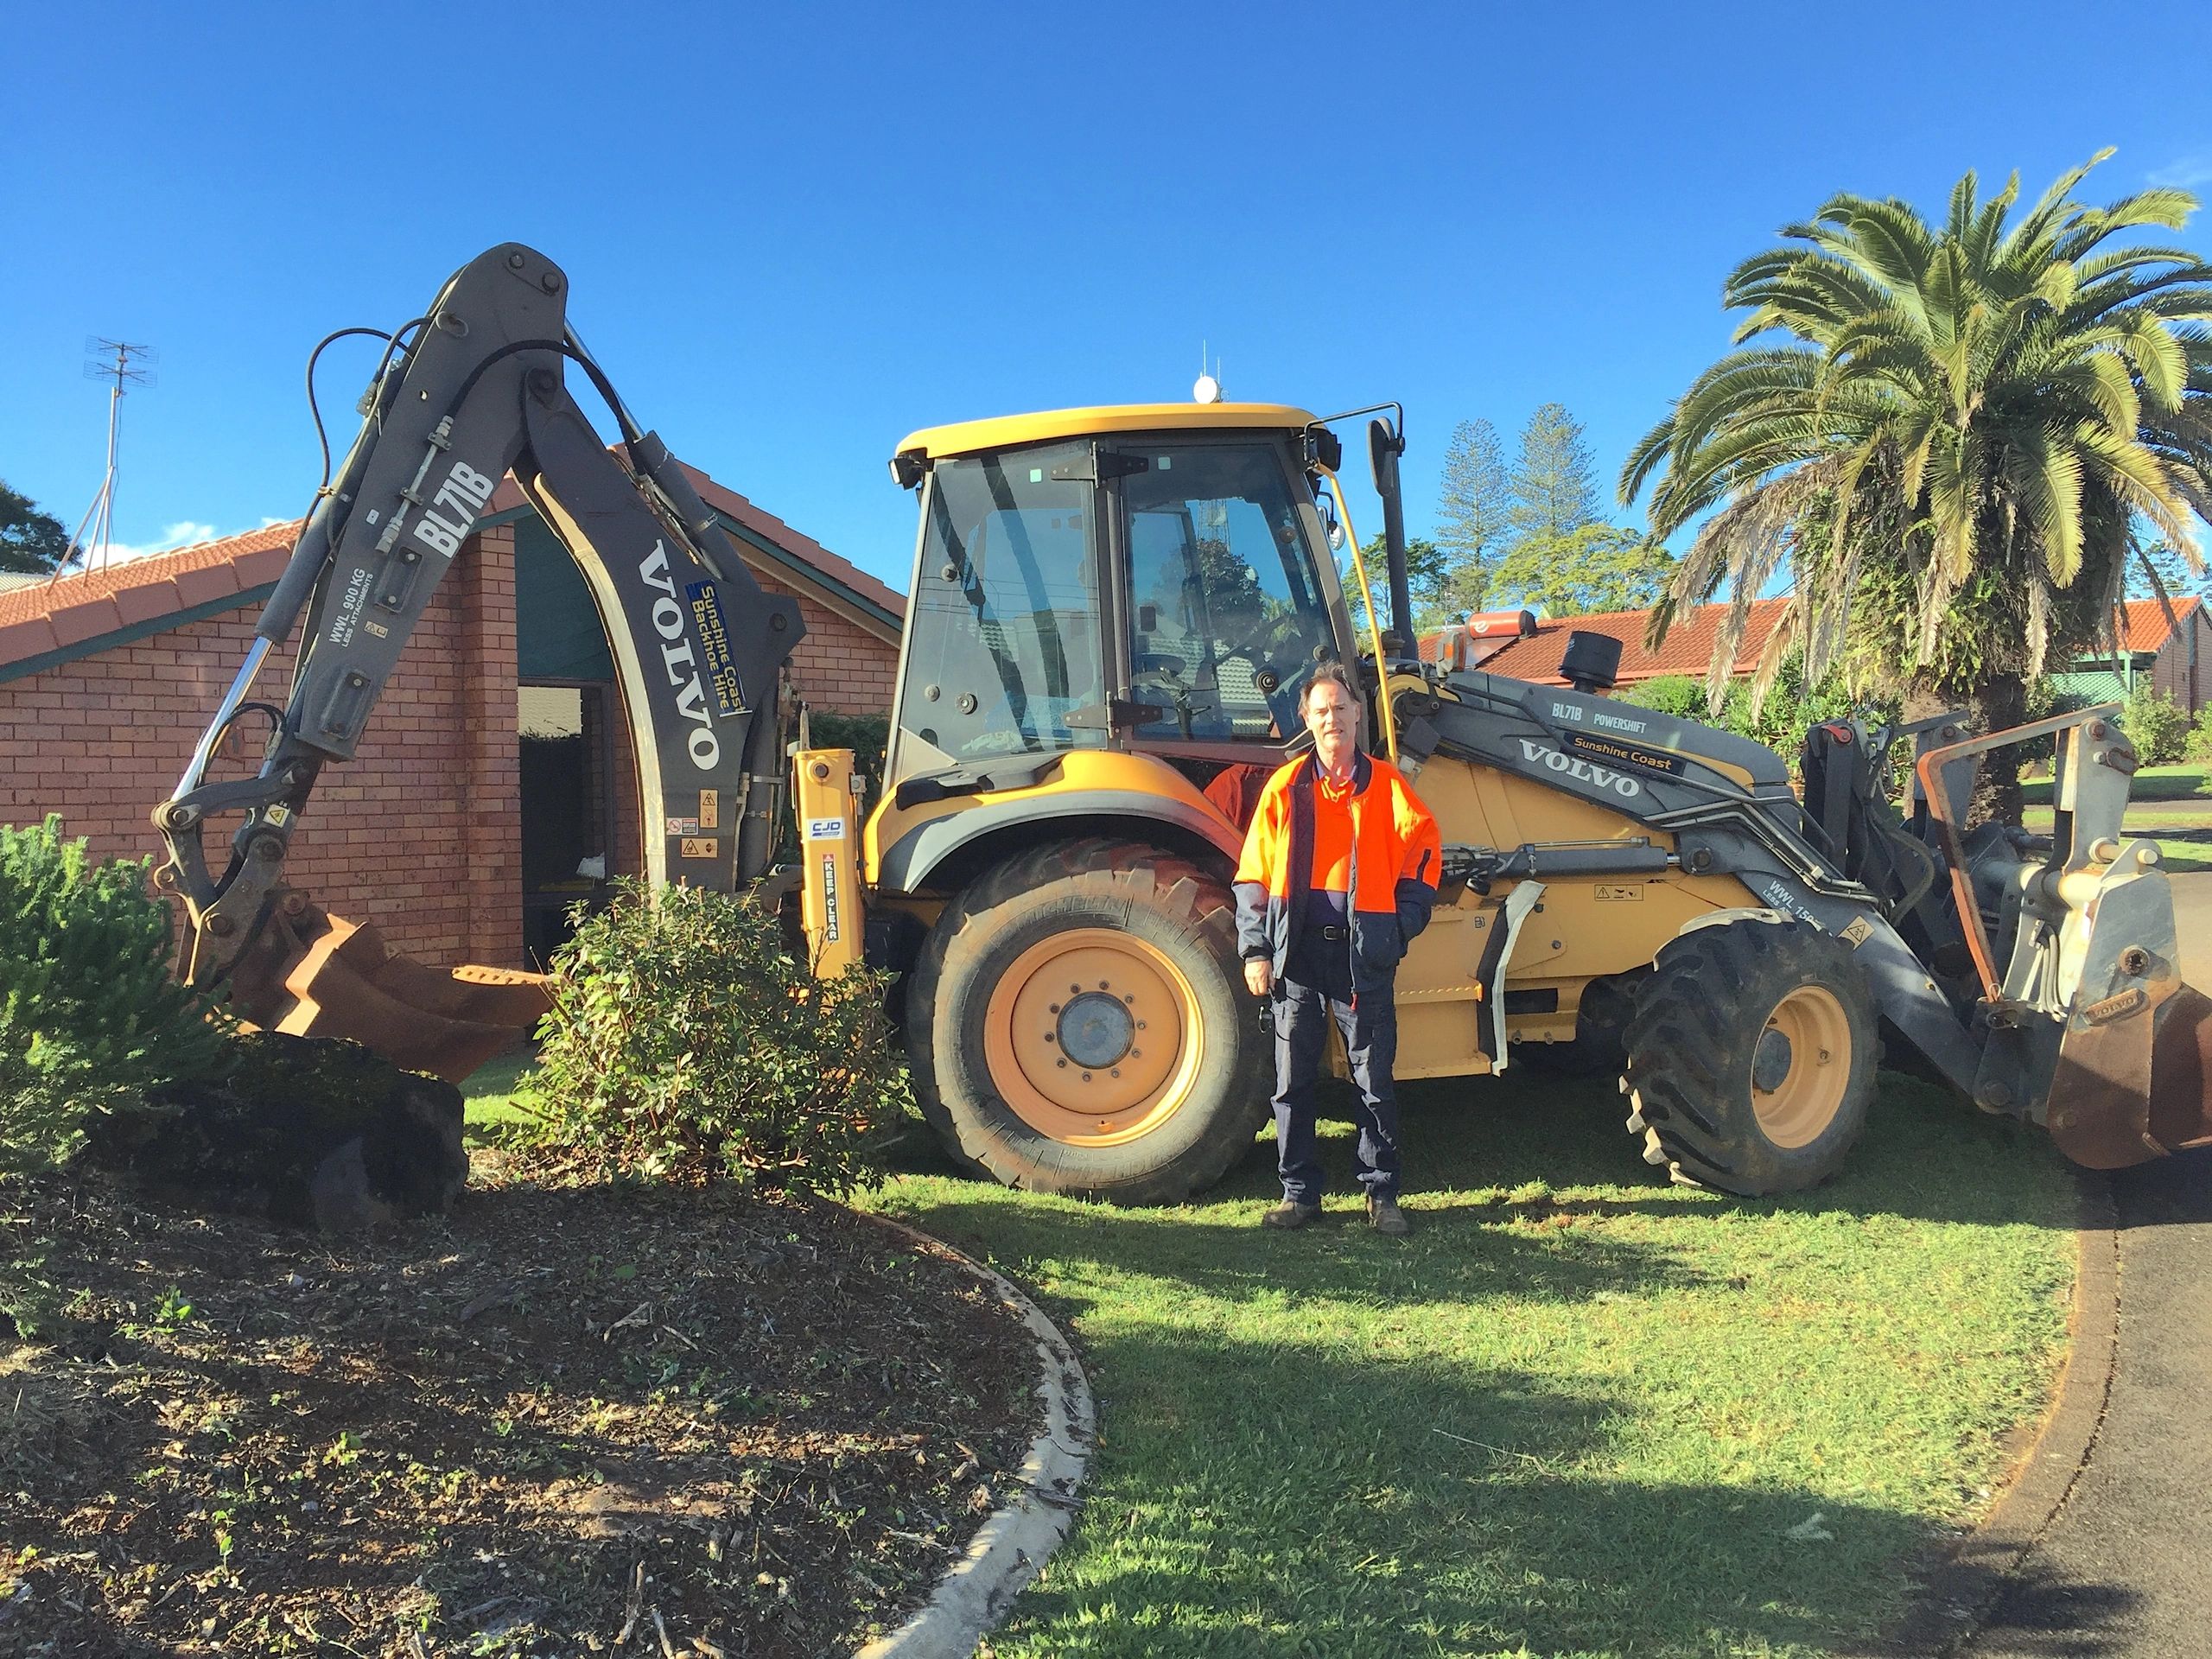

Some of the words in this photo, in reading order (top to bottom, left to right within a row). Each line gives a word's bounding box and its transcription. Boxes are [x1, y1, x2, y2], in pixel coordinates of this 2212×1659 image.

[413, 461, 494, 558] BL71B
[350, 568, 365, 587] KG
[341, 627, 353, 648] LESS
[350, 573, 373, 626] ATTACHMENTS
[342, 588, 359, 610] 900
[328, 614, 349, 644] WWL
[639, 538, 720, 771] VOLVO
[692, 600, 719, 671] Backhoe
[712, 674, 729, 709] Hire
[701, 585, 729, 662] Sunshine
[724, 666, 746, 712] Coast
[1552, 702, 1583, 721] BL71B
[1593, 713, 1647, 734] POWERSHIFT
[1519, 739, 1639, 798] VOLVO
[1573, 737, 1629, 759] Sunshine
[1630, 751, 1672, 770] Coast
[812, 822, 841, 831] CJD
[825, 862, 835, 895] KEEP
[1770, 880, 1795, 909] WWL
[1763, 889, 1780, 906] LESS
[827, 898, 837, 939] CLEAR
